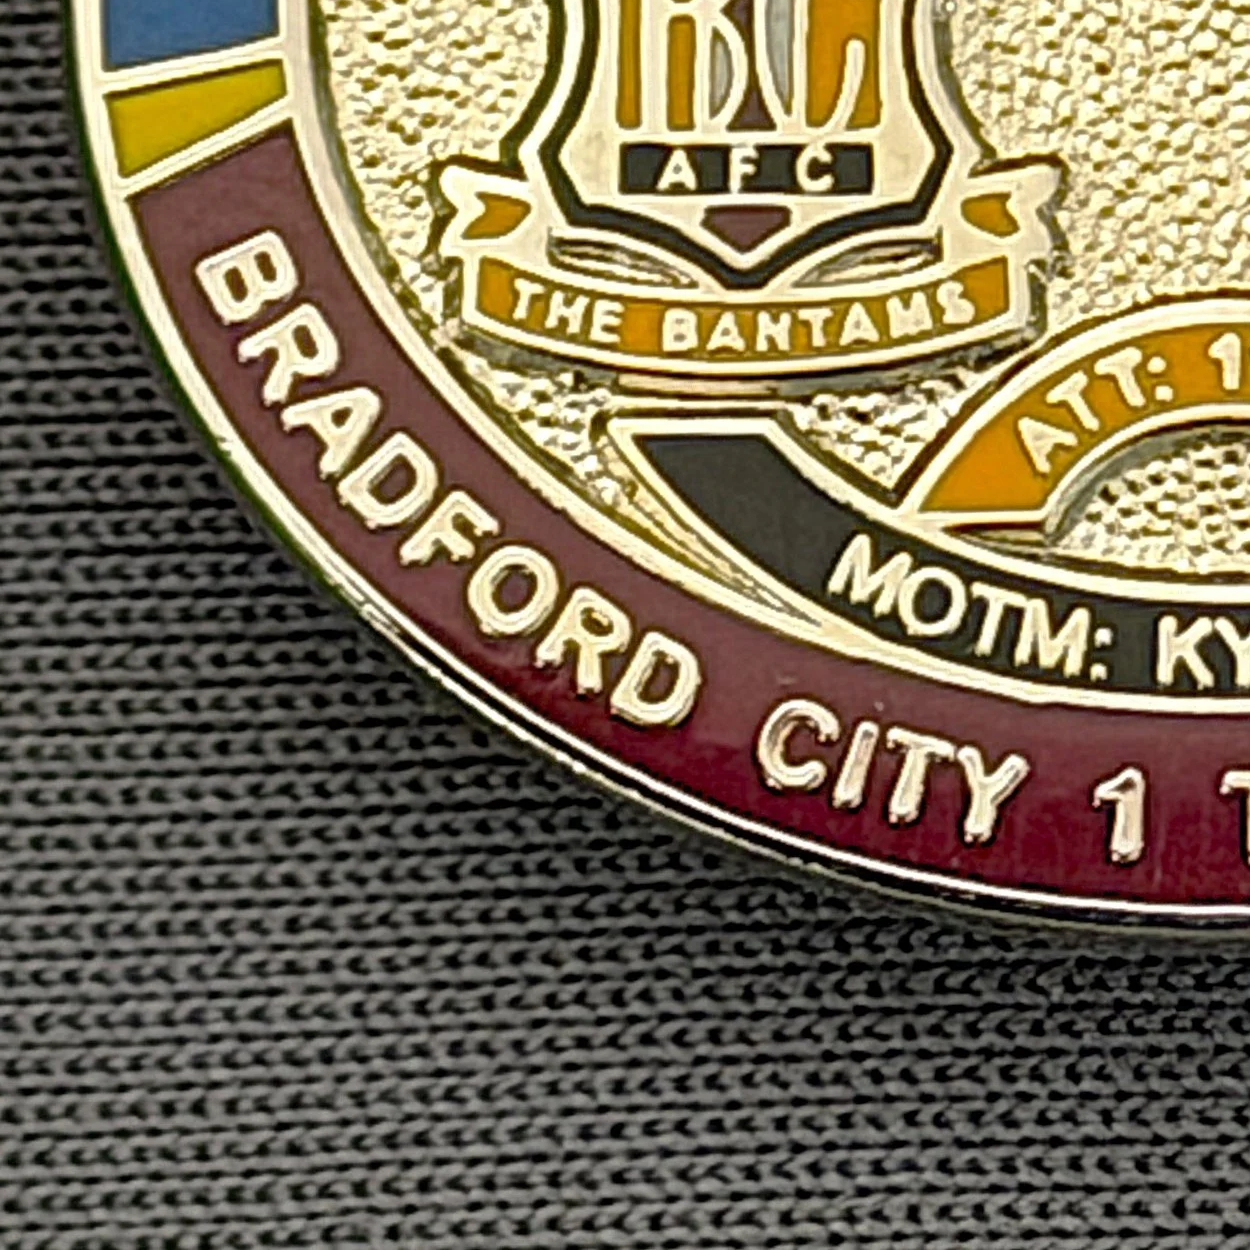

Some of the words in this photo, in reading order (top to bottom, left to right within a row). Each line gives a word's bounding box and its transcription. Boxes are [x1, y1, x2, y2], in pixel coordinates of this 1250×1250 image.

[511, 279, 625, 344] THE
[661, 280, 976, 352] BANTAMS
[1014, 346, 1174, 474] ATT:
[196, 230, 700, 727] BRADFORD
[757, 698, 1030, 842] CITY
[1092, 766, 1147, 864] 1
[828, 534, 1111, 679] MOTM:
